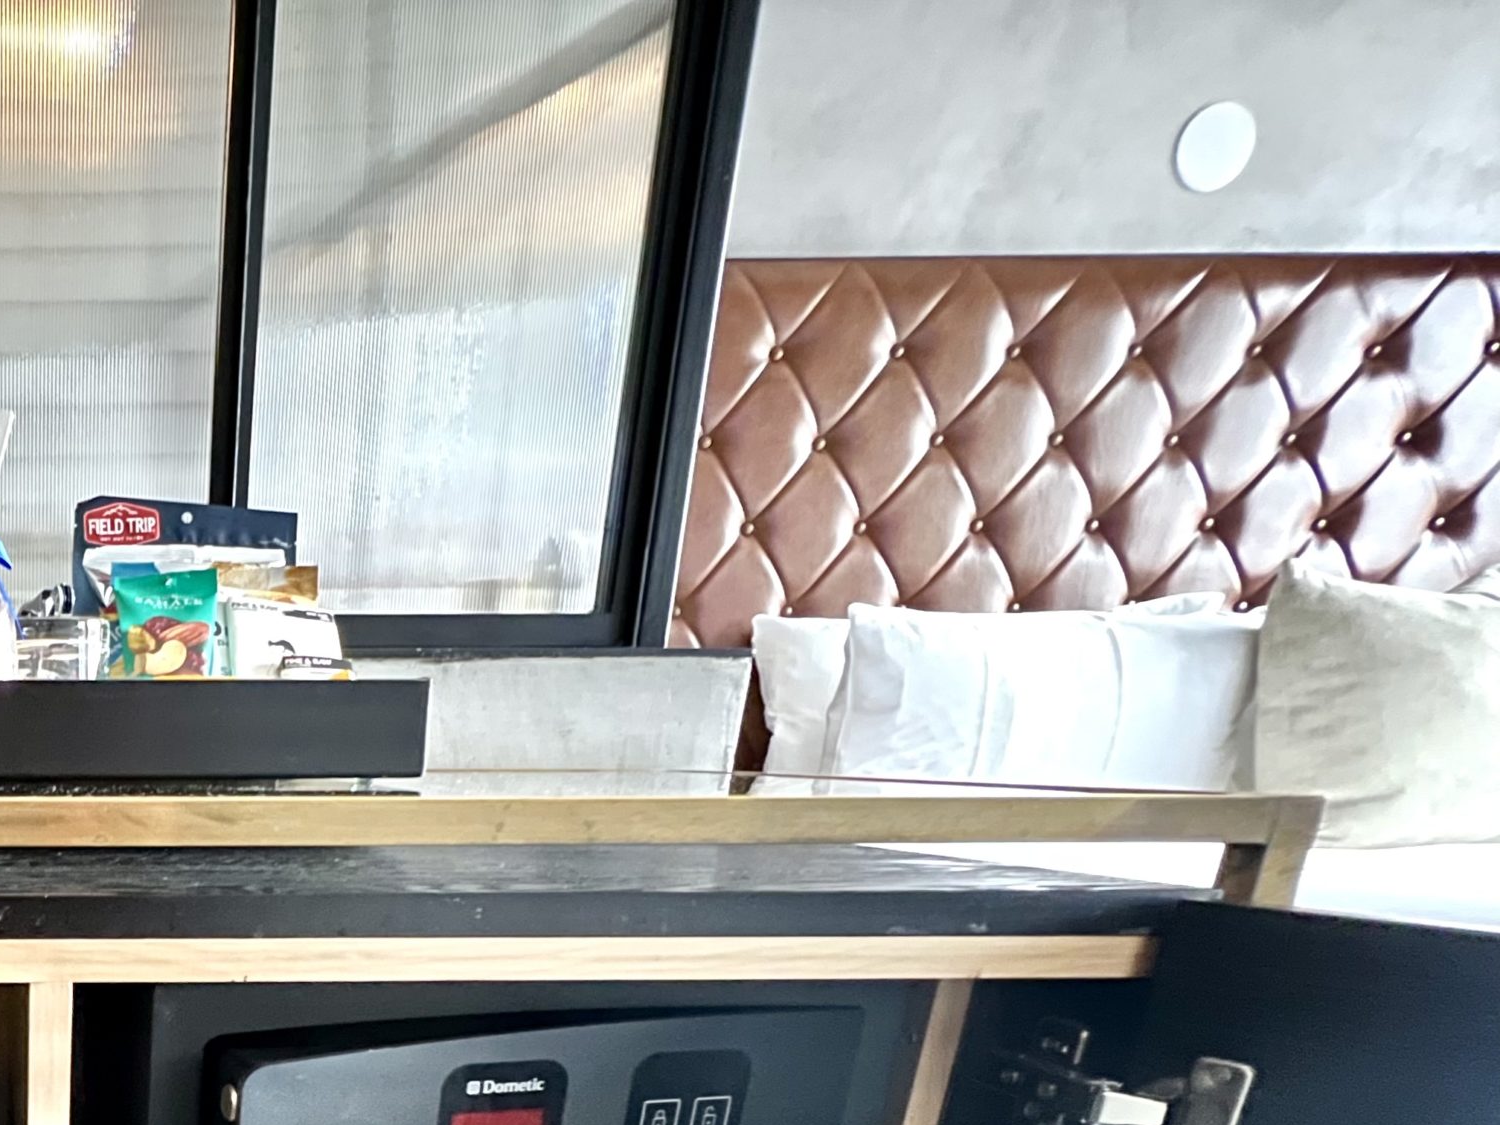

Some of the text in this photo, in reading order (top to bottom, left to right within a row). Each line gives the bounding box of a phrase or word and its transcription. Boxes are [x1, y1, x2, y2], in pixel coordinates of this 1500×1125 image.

[88, 517, 156, 535] FIELD TRIP
[482, 1078, 545, 1094] Dometic
